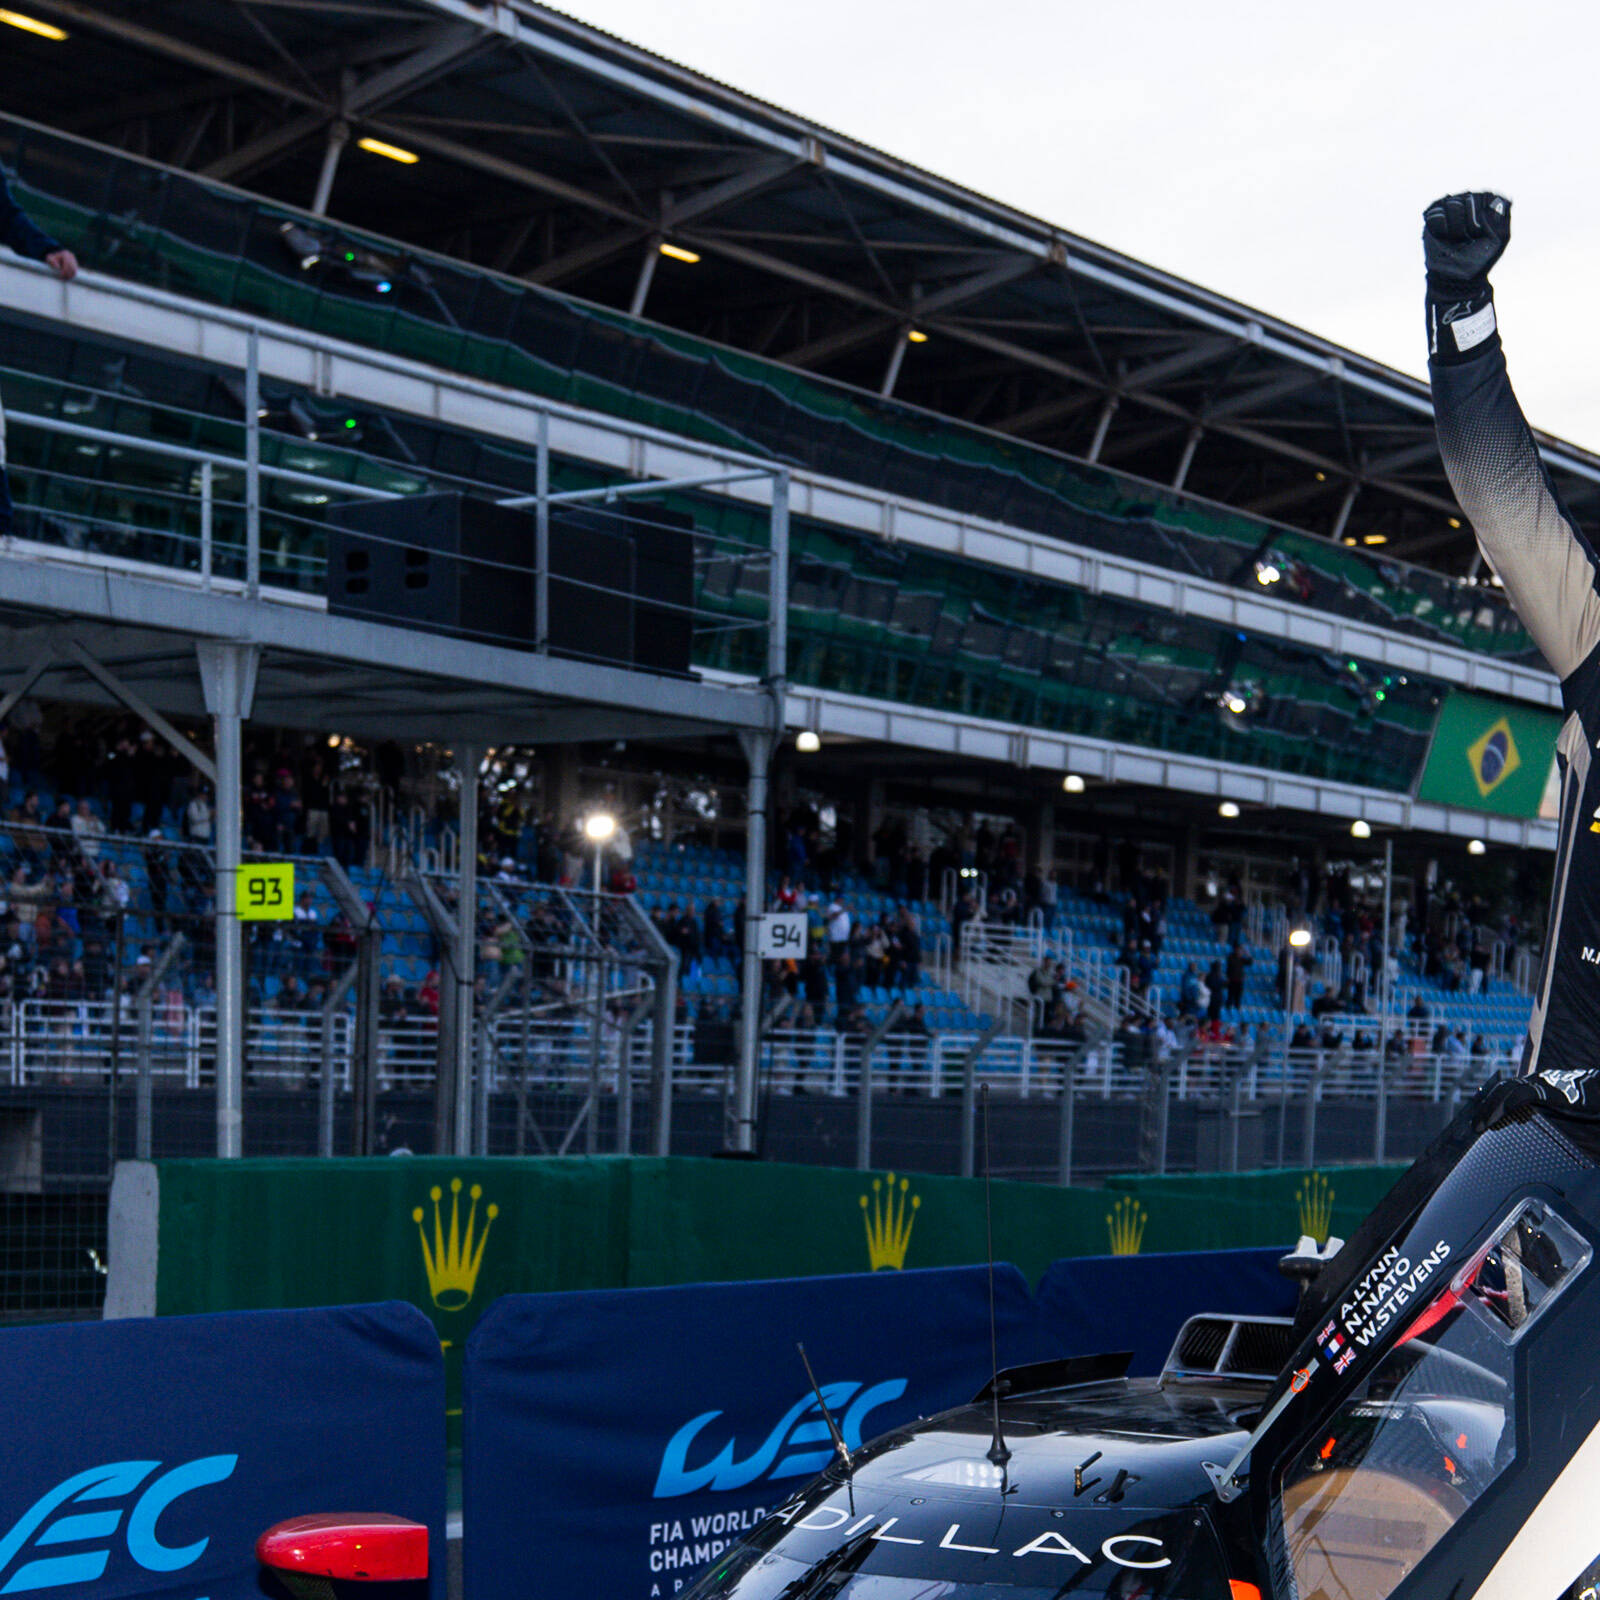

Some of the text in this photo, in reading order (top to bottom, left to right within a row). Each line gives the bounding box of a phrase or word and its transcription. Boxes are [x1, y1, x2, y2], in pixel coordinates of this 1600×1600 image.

[248, 877, 282, 906] 93
[772, 924, 801, 948] 94
[1341, 1245, 1400, 1320] A.LYNN
[1345, 1257, 1411, 1335] N.NATO
[1355, 1239, 1451, 1346] W.STEVENS
[650, 1507, 767, 1546] FIA WORLD
[766, 1493, 1172, 1570] ADILLAC
[650, 1538, 732, 1573] CHAMP
